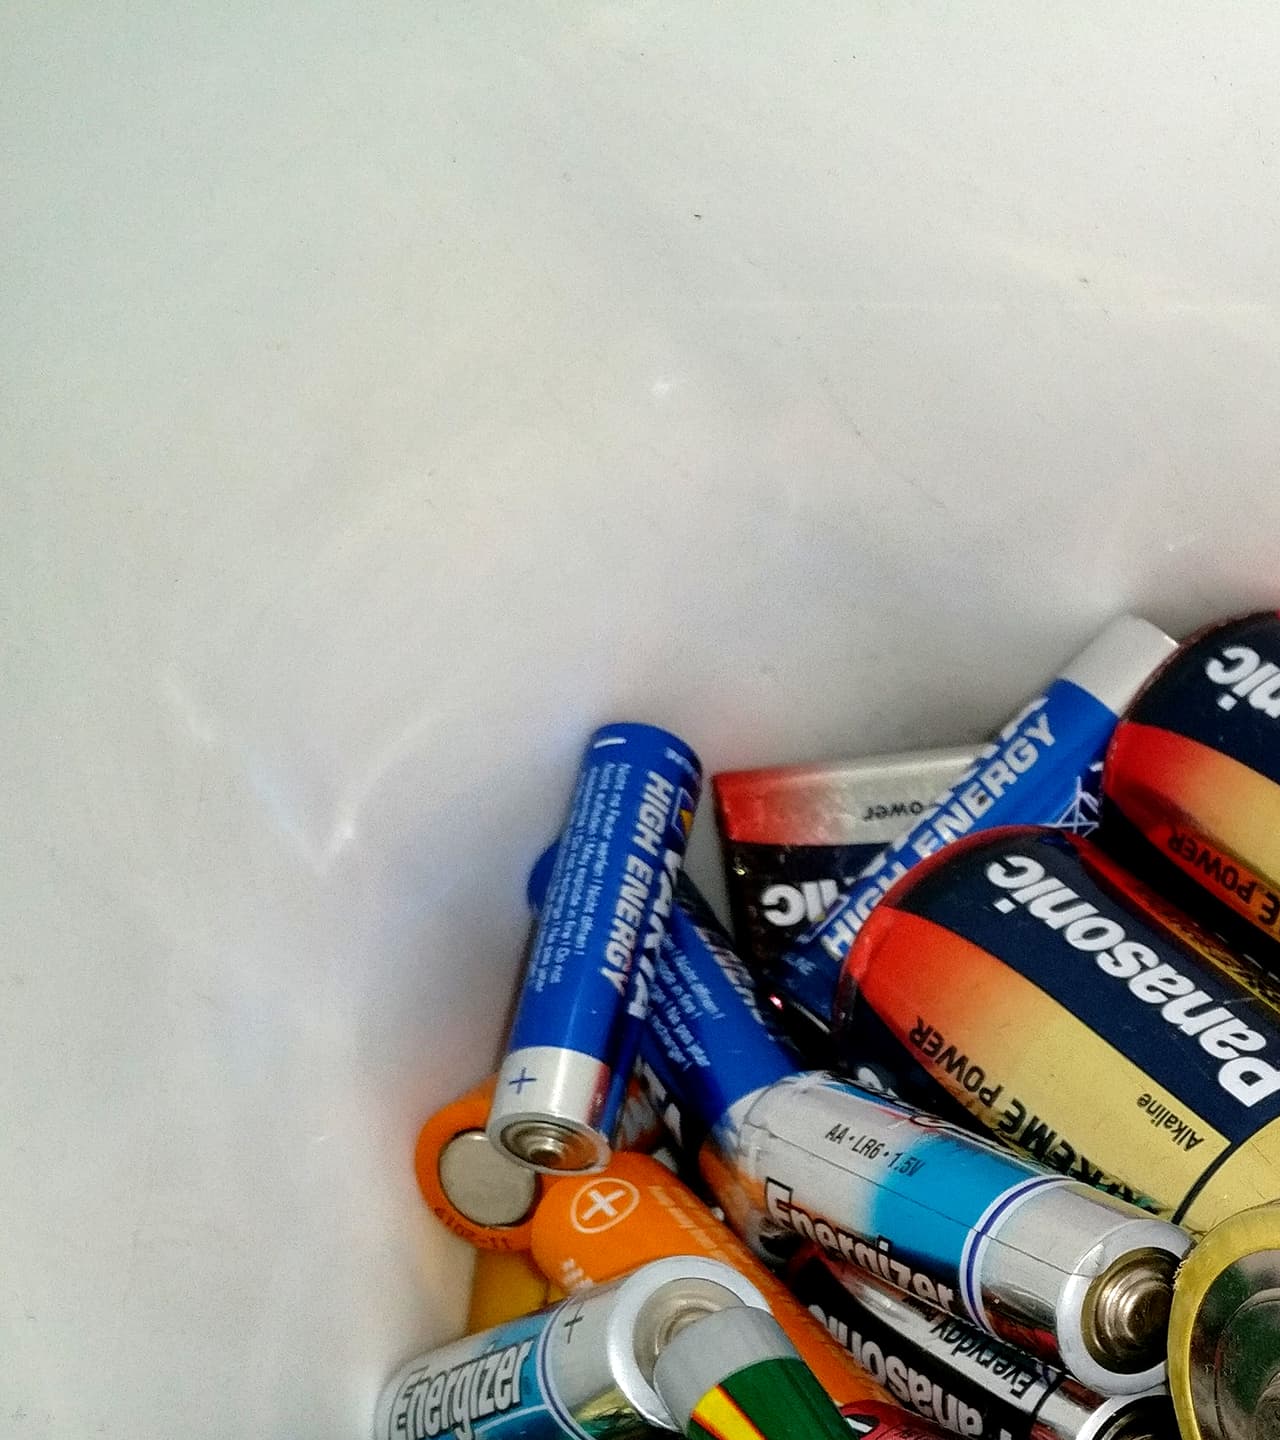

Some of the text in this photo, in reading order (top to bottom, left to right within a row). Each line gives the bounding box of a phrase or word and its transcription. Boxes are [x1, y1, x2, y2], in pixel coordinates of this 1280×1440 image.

[916, 711, 1057, 861] ENERGY
[601, 769, 674, 996] HIGH ENERGY
[908, 1015, 1012, 1110] POWER
[1135, 1091, 1204, 1151] Alkaline
